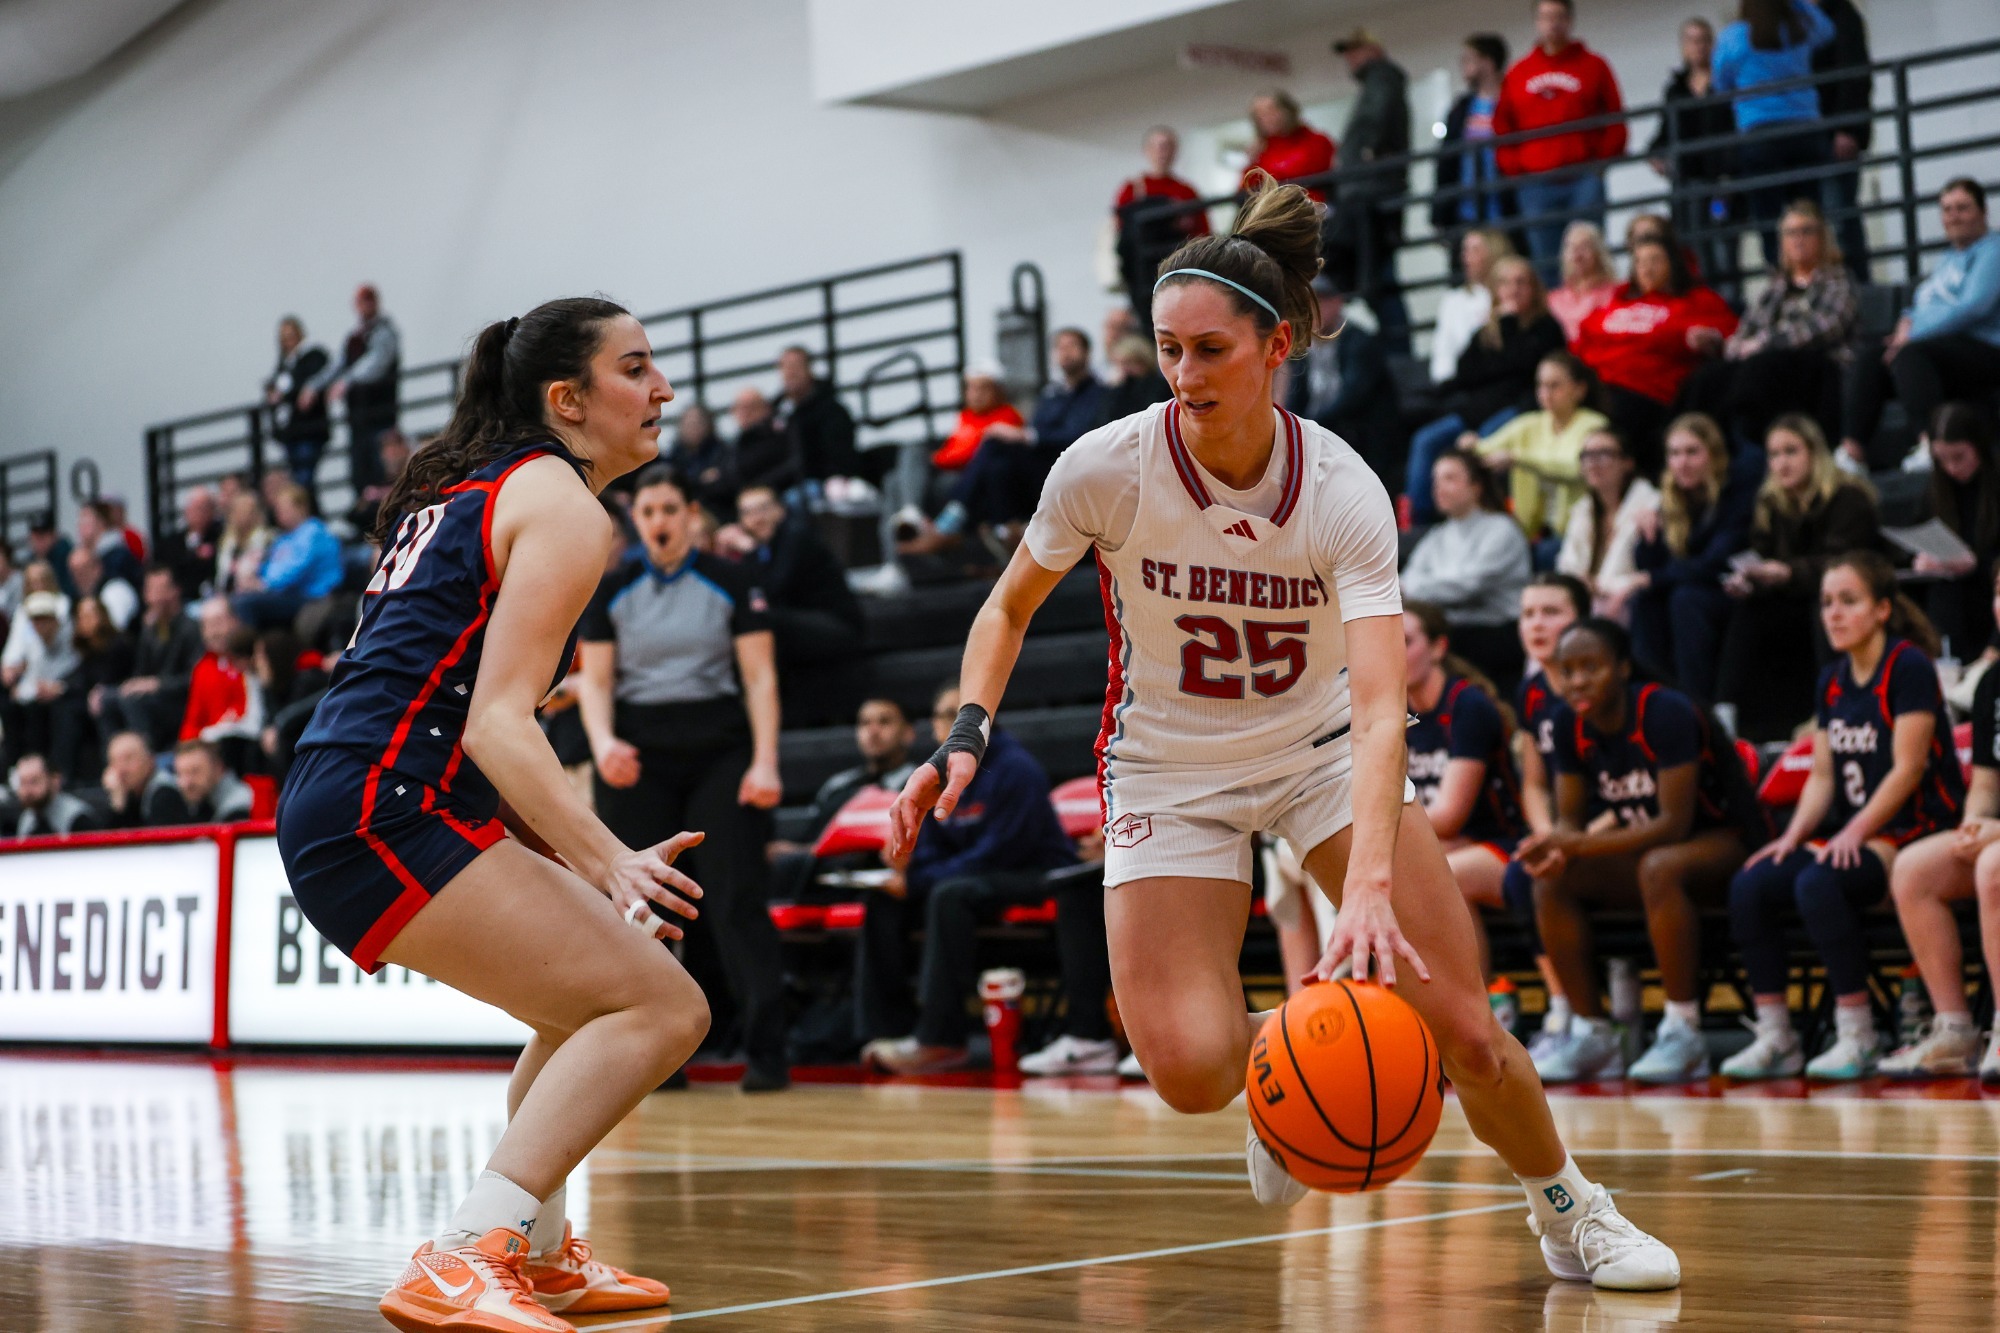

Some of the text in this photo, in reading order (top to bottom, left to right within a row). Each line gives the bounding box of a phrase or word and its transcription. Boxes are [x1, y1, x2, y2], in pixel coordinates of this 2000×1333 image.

[1141, 557, 1329, 610] ST. BENEDIC
[1173, 613, 1310, 700] 25
[1842, 759, 1867, 807] 2
[0, 894, 199, 991] NEDICT
